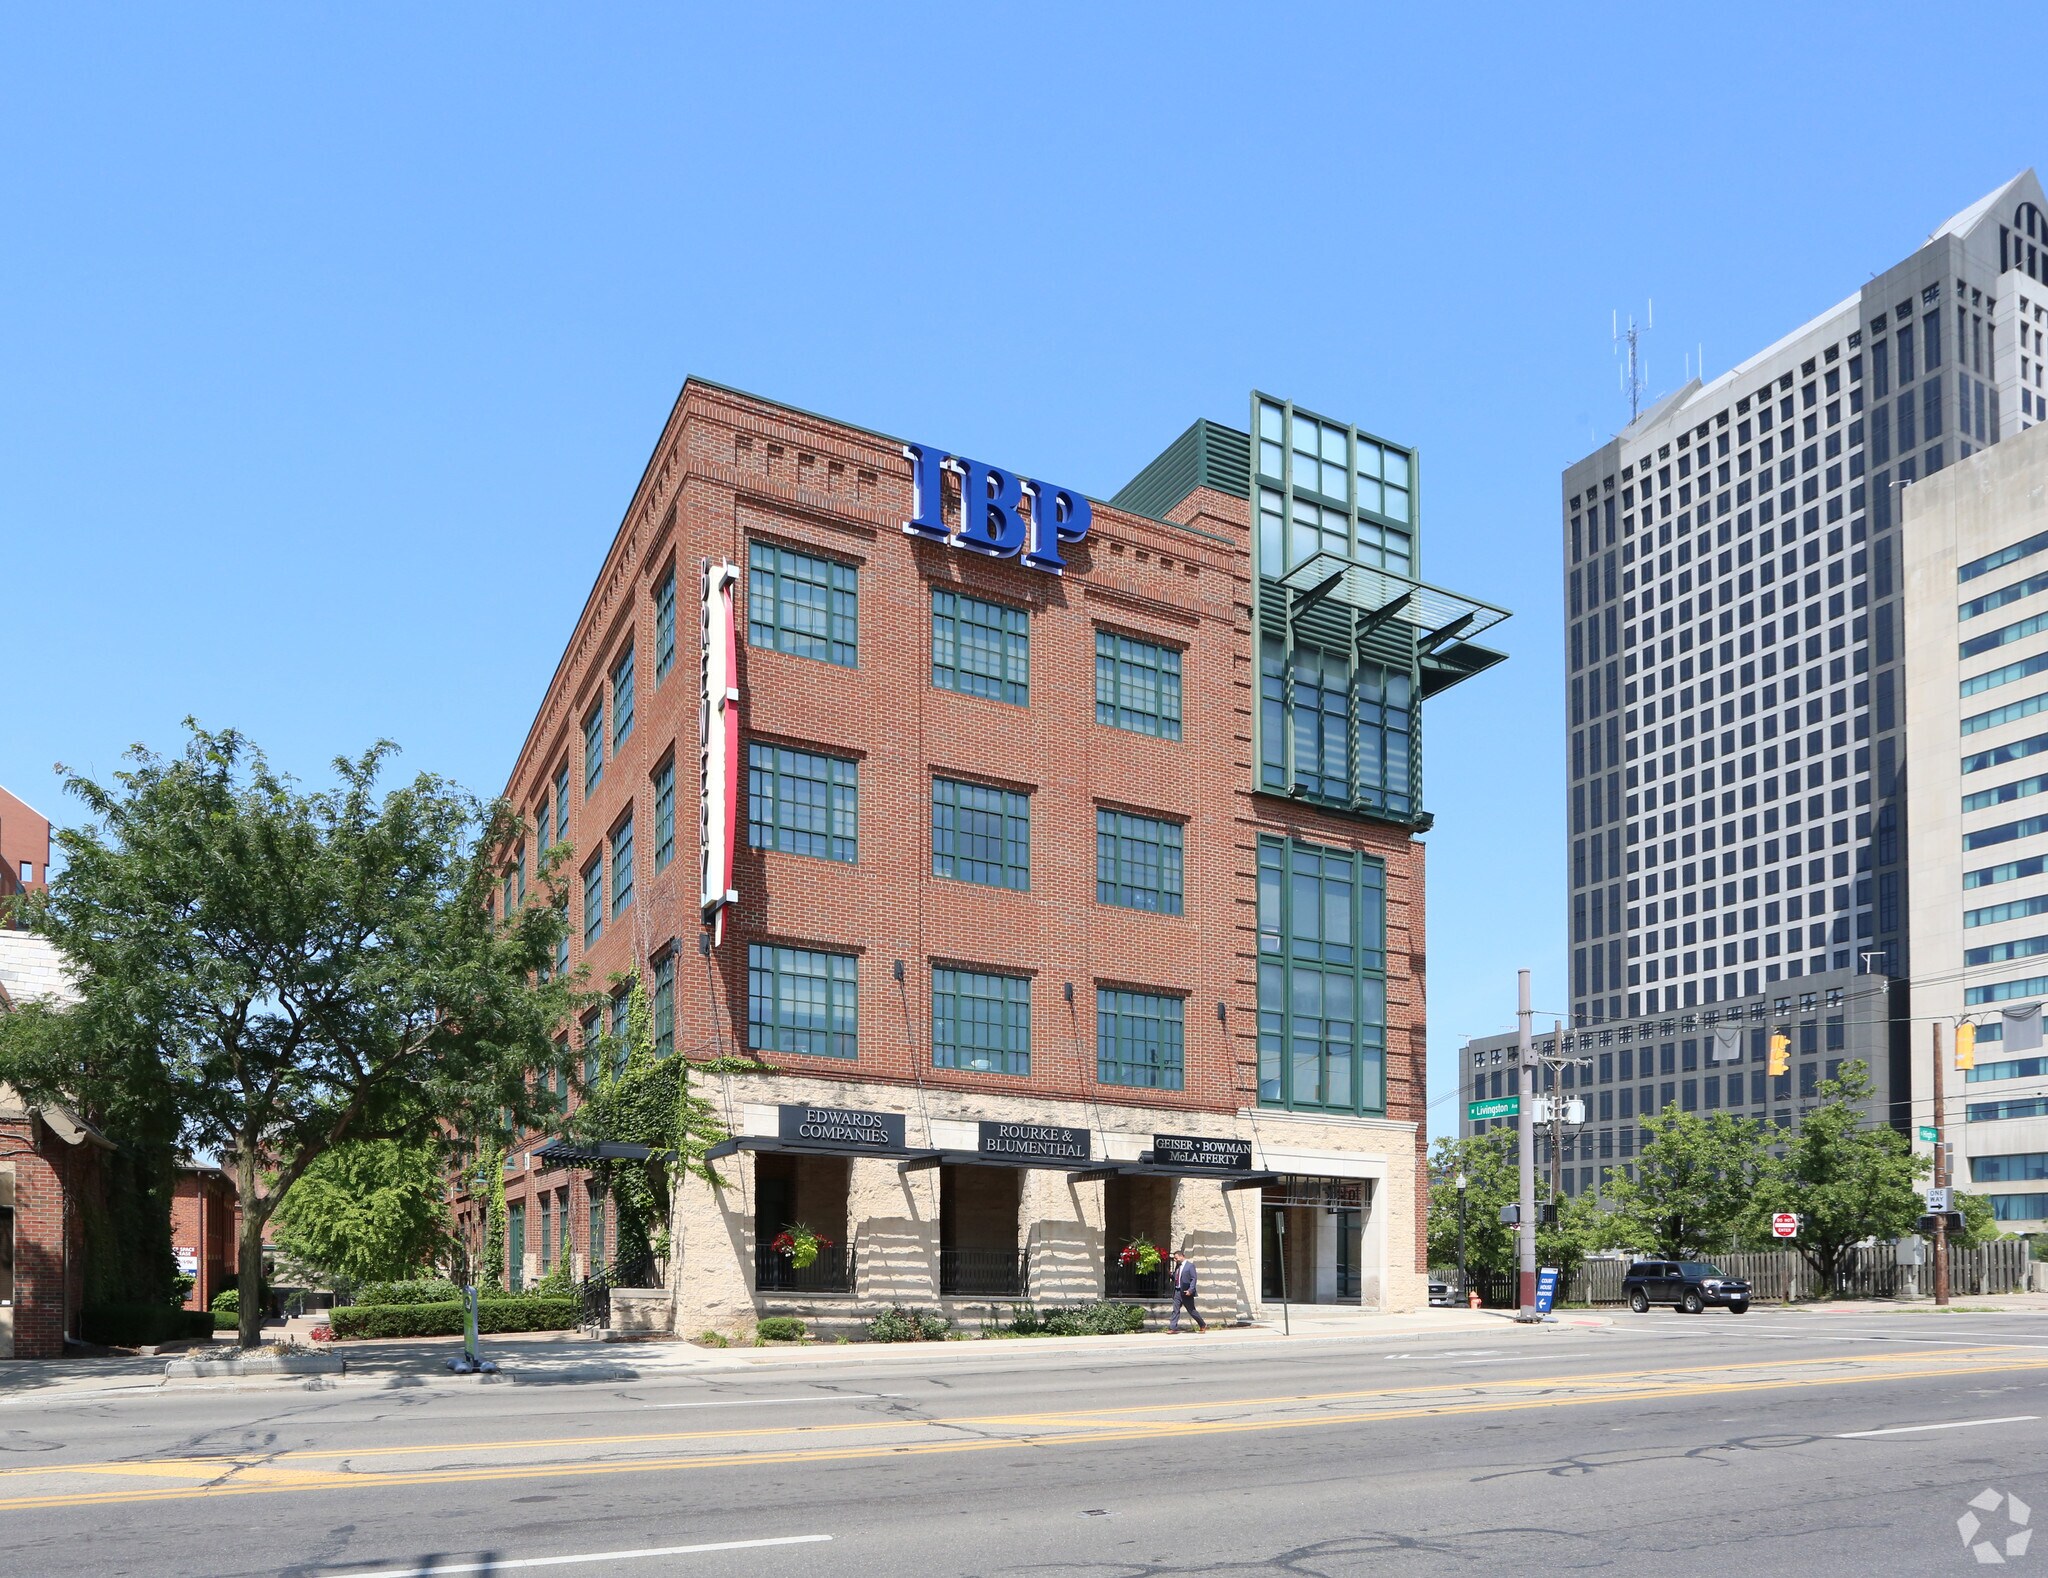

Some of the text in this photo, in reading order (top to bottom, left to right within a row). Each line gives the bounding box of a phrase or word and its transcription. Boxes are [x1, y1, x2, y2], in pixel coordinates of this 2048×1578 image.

[904, 442, 1092, 575] IBP
[806, 1109, 882, 1128] EDWARDS
[1476, 1103, 1509, 1117] Livingston
[799, 1124, 889, 1143] COMPANIES
[999, 1124, 1073, 1142] ROURKE &
[986, 1138, 1085, 1157] BLUMENTHAL
[1155, 1138, 1251, 1154] GEISER BOWMAN
[1169, 1151, 1239, 1165] McLAFFERTY
